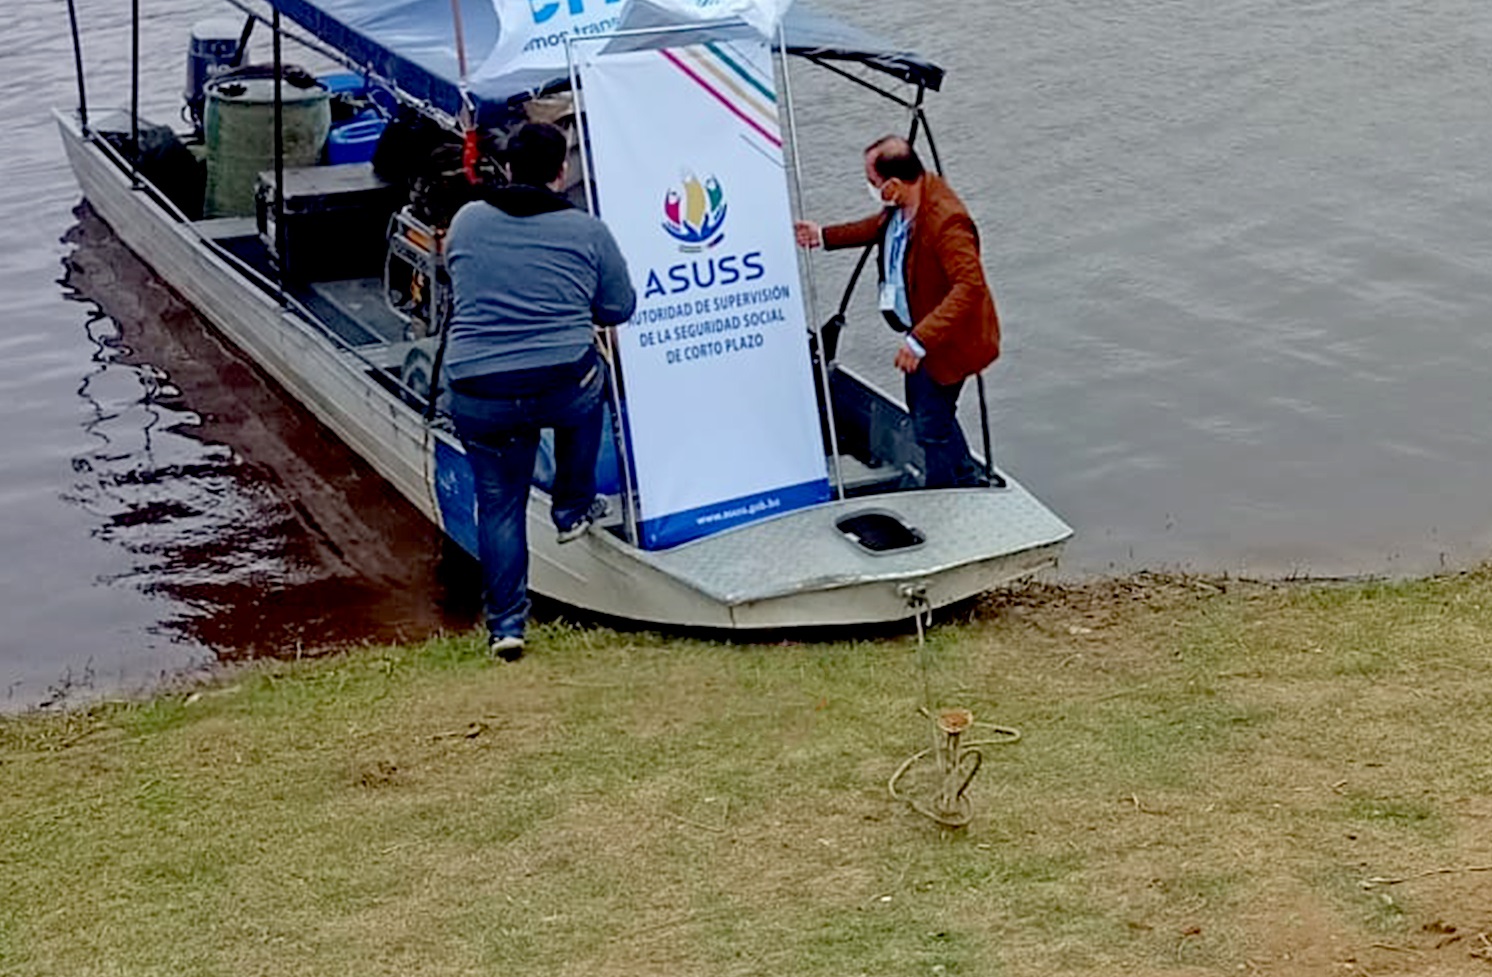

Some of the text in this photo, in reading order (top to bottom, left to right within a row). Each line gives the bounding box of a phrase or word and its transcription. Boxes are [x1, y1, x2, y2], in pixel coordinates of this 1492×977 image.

[644, 251, 765, 299] ASUSS
[694, 298, 711, 315] DE
[713, 284, 790, 312] SUPERVISIÓN
[639, 307, 786, 348] DE LA SEGURIDAD SOCIAL
[666, 333, 764, 365] DE CORTO PLAZO
